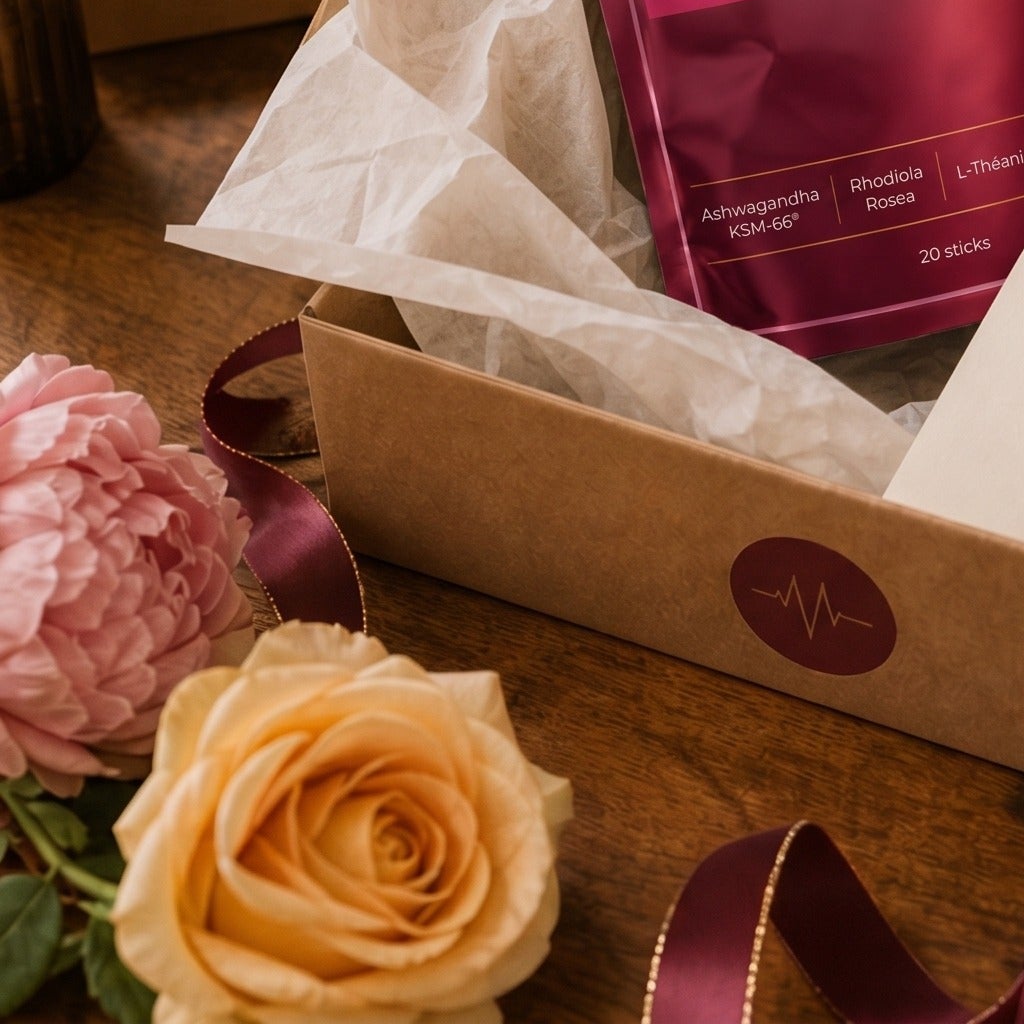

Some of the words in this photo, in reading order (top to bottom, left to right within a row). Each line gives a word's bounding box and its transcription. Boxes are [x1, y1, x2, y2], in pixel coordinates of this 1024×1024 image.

[849, 165, 924, 193] Rhodiola
[700, 188, 821, 223] Ashwagandha
[865, 189, 916, 212] Rosea
[918, 245, 941, 264] 20
[944, 236, 992, 260] sticks
